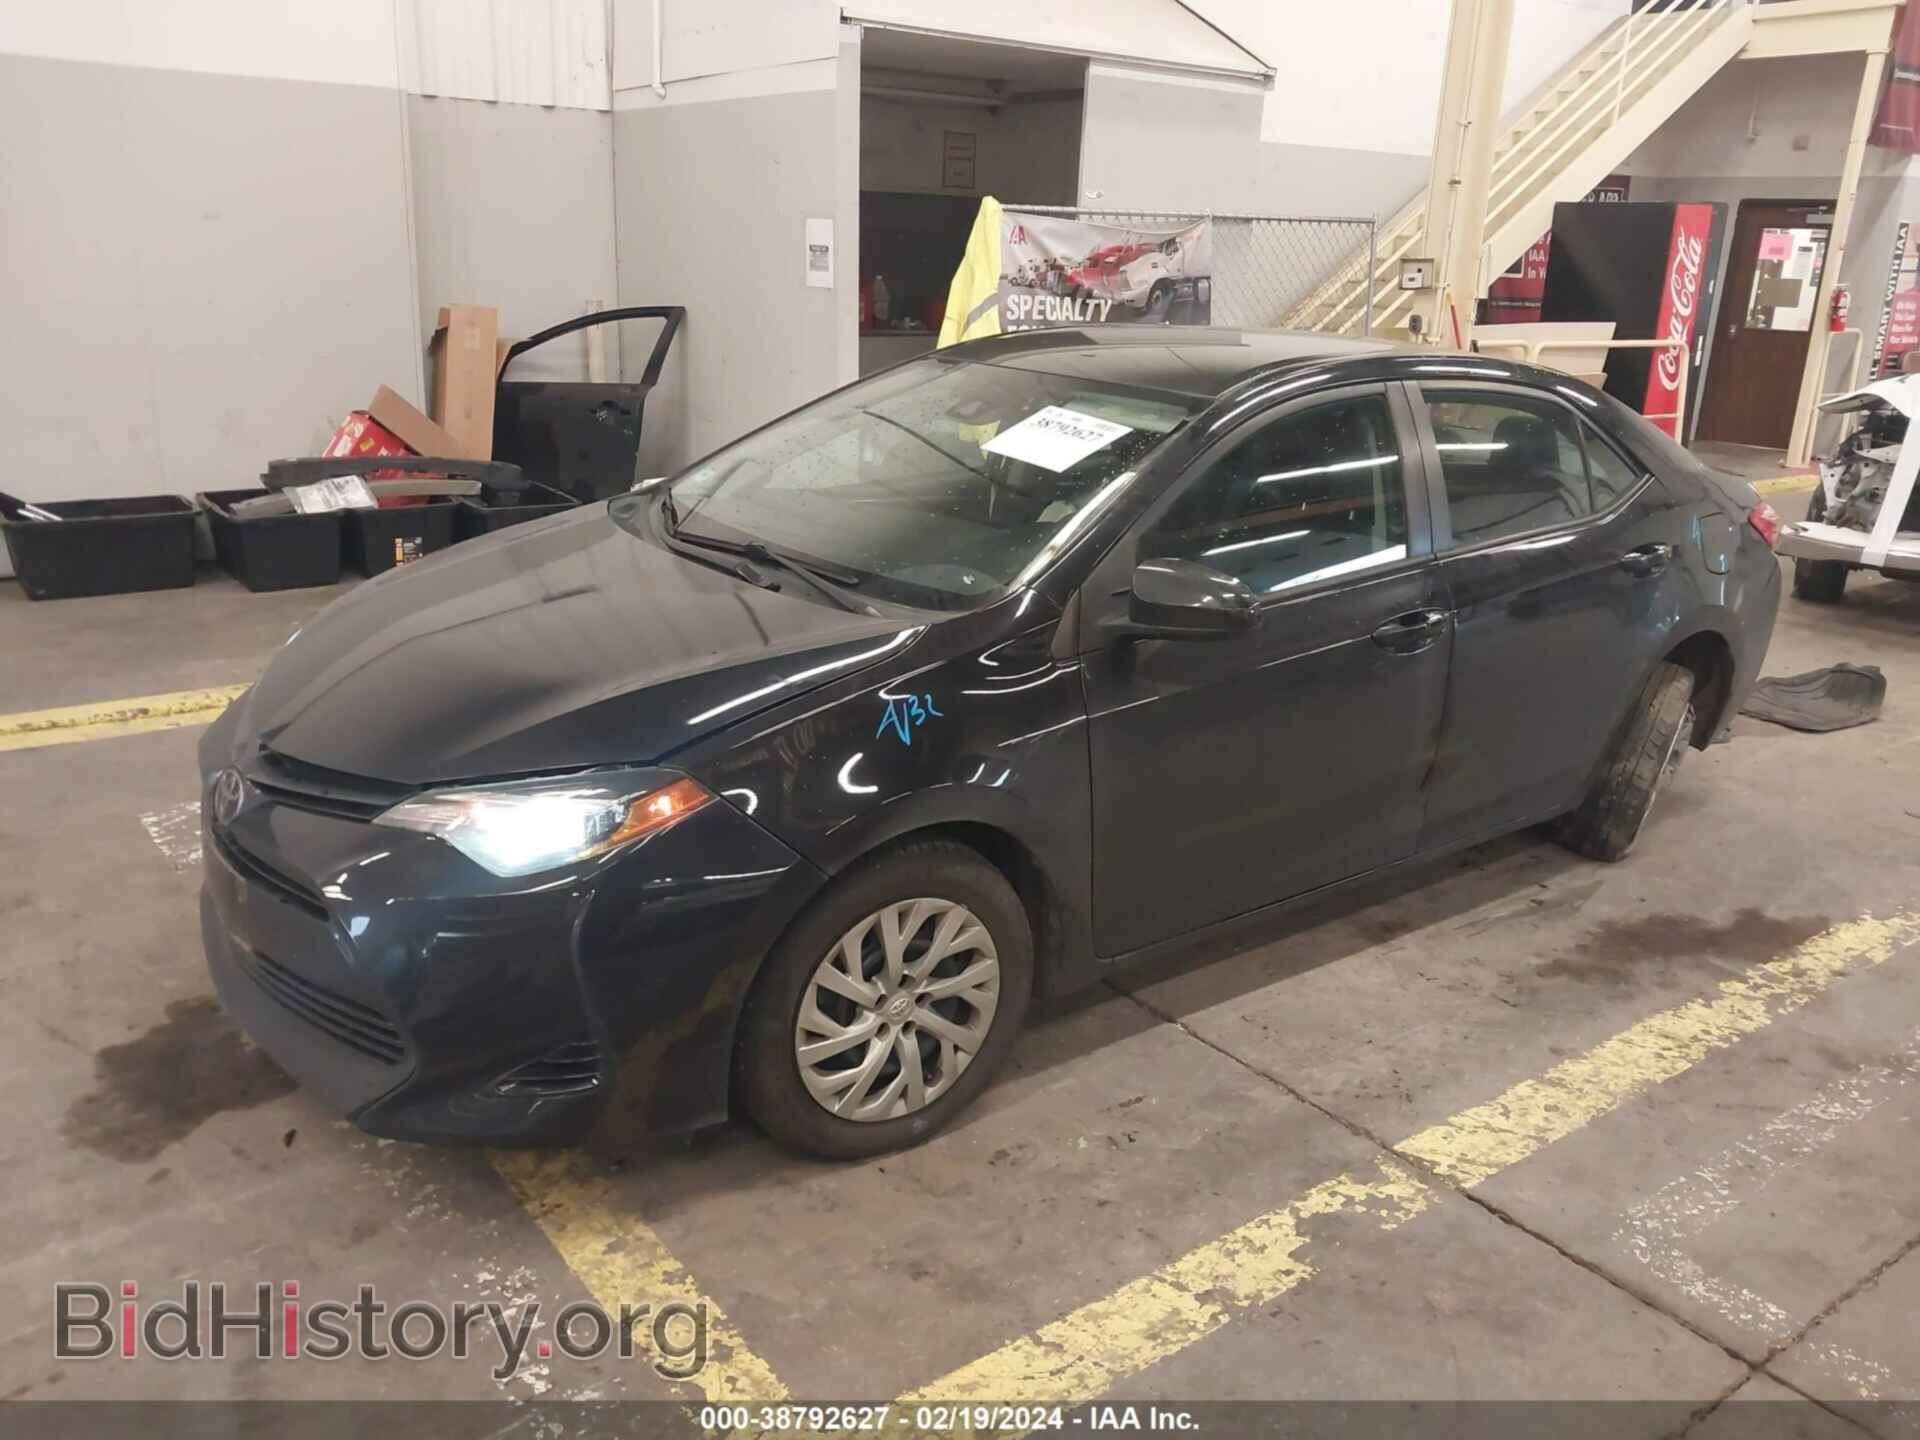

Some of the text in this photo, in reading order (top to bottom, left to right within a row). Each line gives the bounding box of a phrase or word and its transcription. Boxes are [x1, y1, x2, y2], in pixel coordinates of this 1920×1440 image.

[1886, 258, 1900, 301] WITH
[1895, 226, 1909, 254] IAA
[1006, 293, 1112, 322] SPECIALTY
[1658, 225, 1702, 391] Coca-Cola
